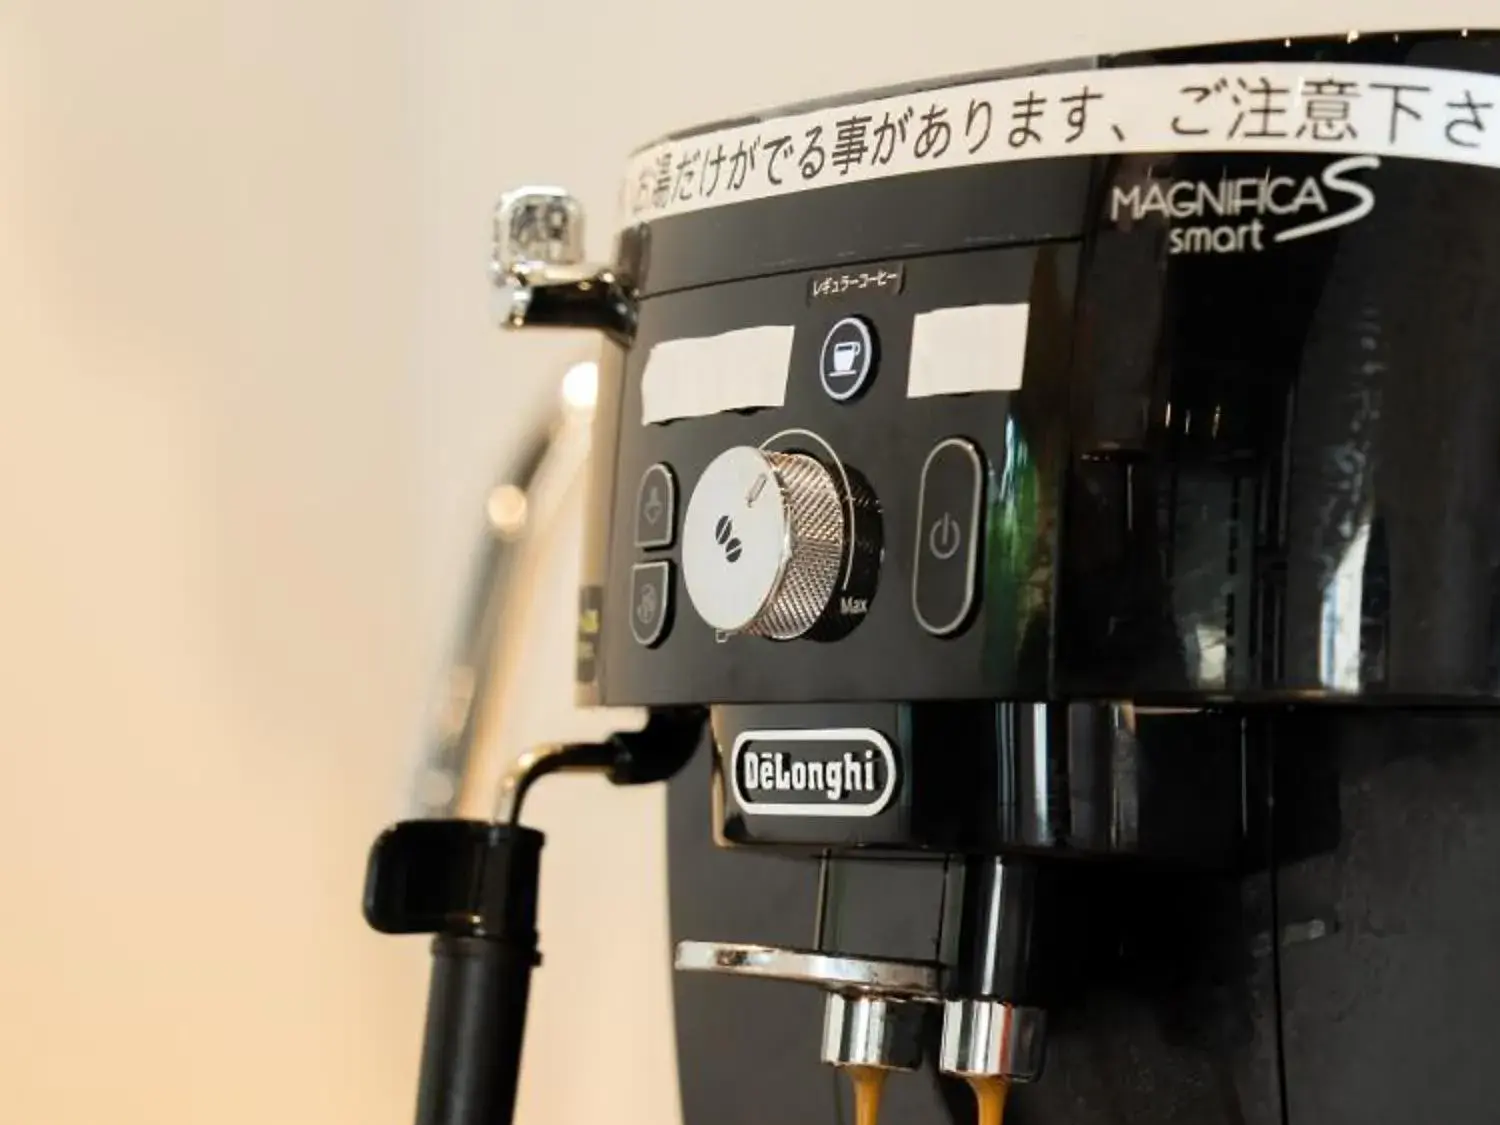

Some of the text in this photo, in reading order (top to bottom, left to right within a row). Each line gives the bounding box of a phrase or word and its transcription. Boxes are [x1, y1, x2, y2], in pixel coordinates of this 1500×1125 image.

[1169, 219, 1264, 254] smart
[813, 270, 897, 296] レギュラーコーヒー
[841, 596, 867, 615] Max
